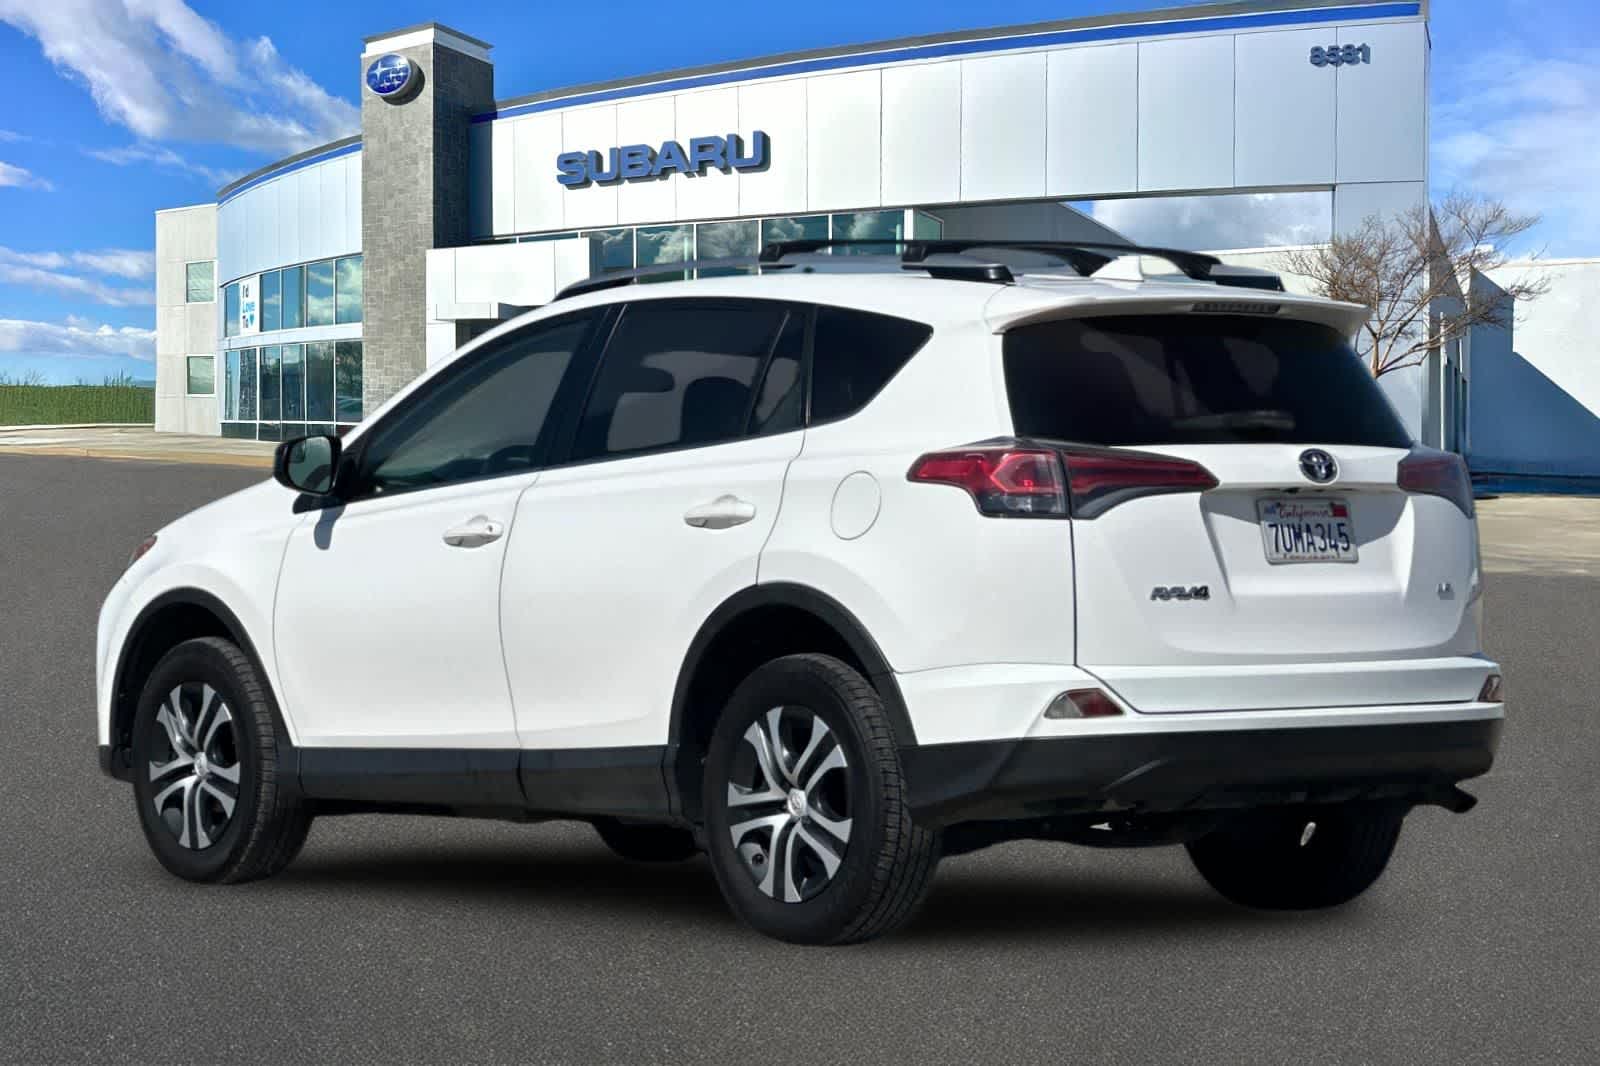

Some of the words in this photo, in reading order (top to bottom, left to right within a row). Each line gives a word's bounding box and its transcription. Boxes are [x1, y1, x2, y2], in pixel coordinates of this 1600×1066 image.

[556, 130, 771, 190] SUBARU
[1279, 503, 1329, 521] California
[1268, 522, 1351, 553] 7UMA345
[1150, 586, 1210, 601] RAV4
